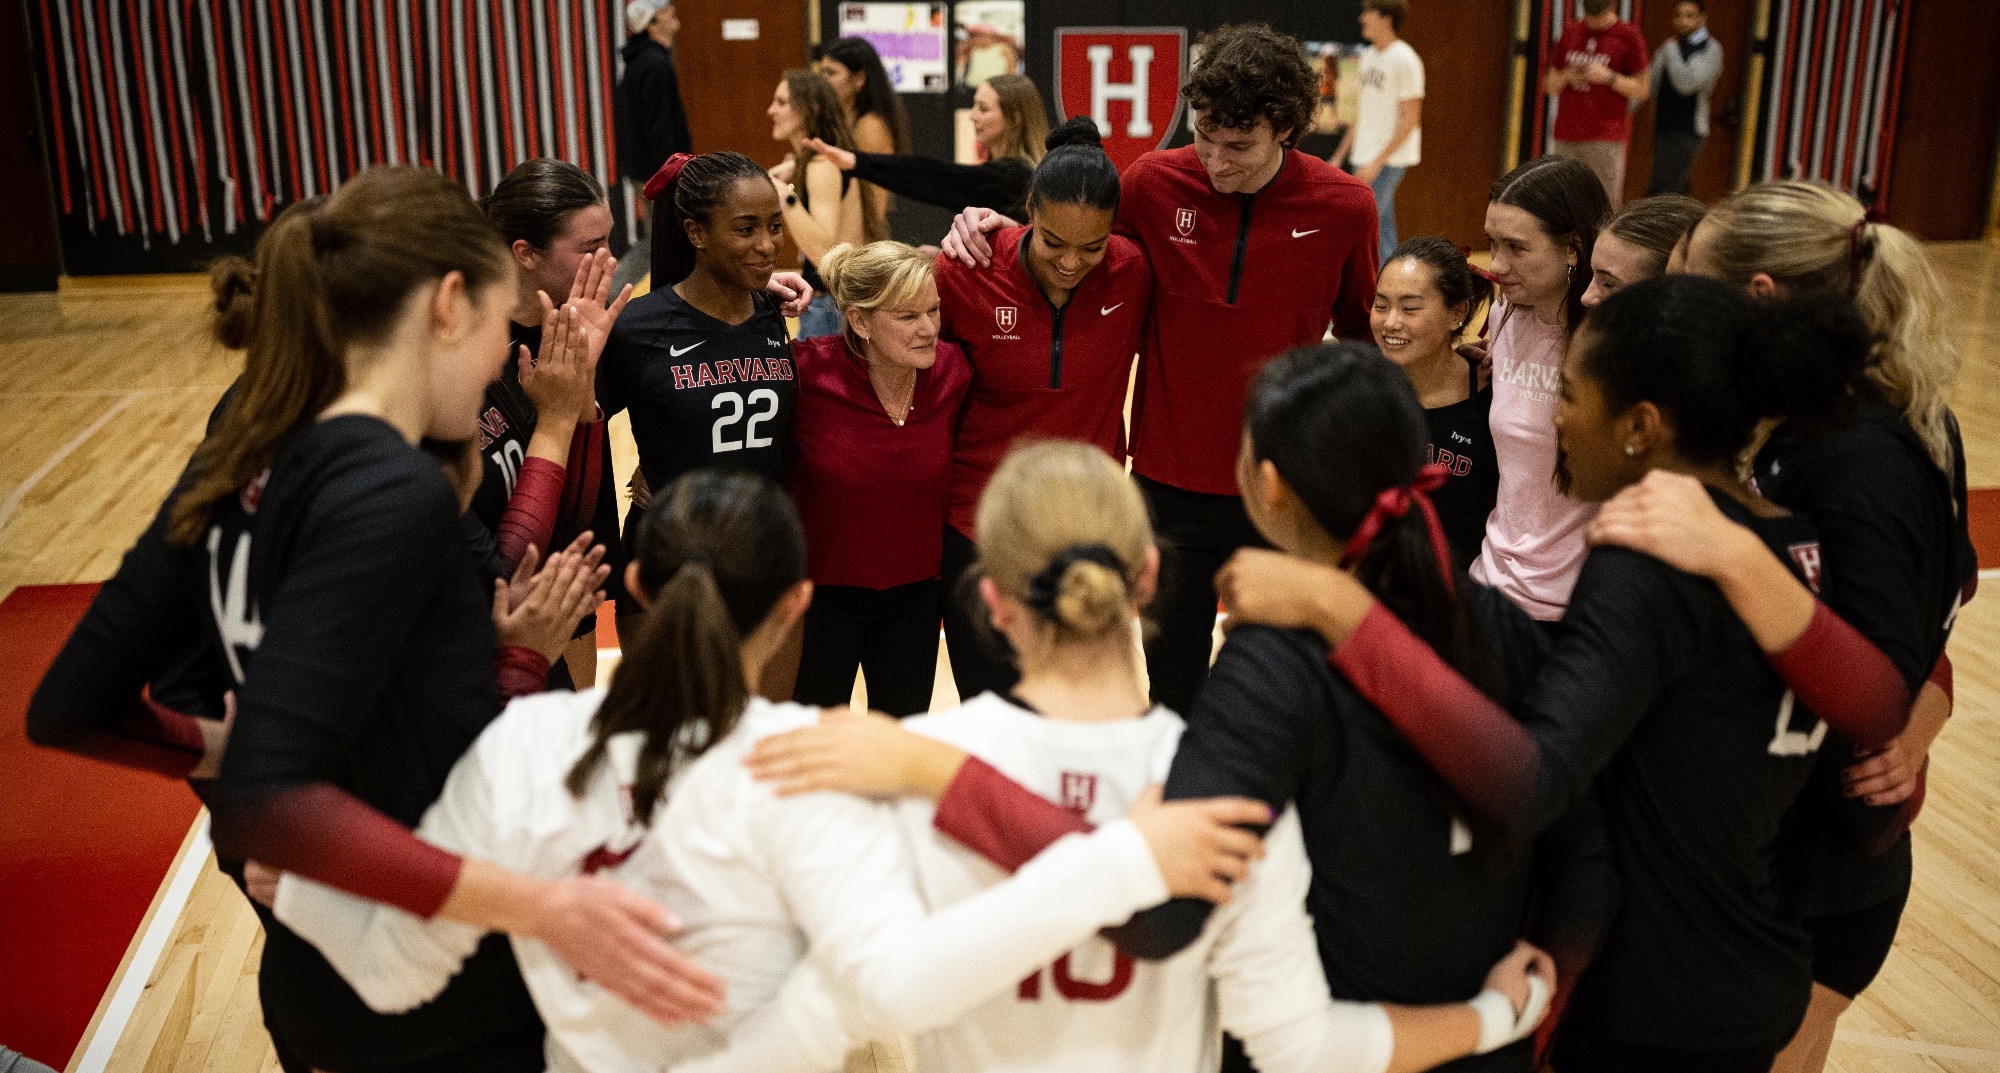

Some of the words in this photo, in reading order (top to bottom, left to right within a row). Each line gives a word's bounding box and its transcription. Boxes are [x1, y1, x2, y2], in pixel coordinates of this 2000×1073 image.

[1087, 44, 1154, 137] H
[1180, 212, 1192, 228] H
[1001, 310, 1012, 325] H
[671, 358, 794, 389] HARVARD
[711, 388, 779, 453] 22
